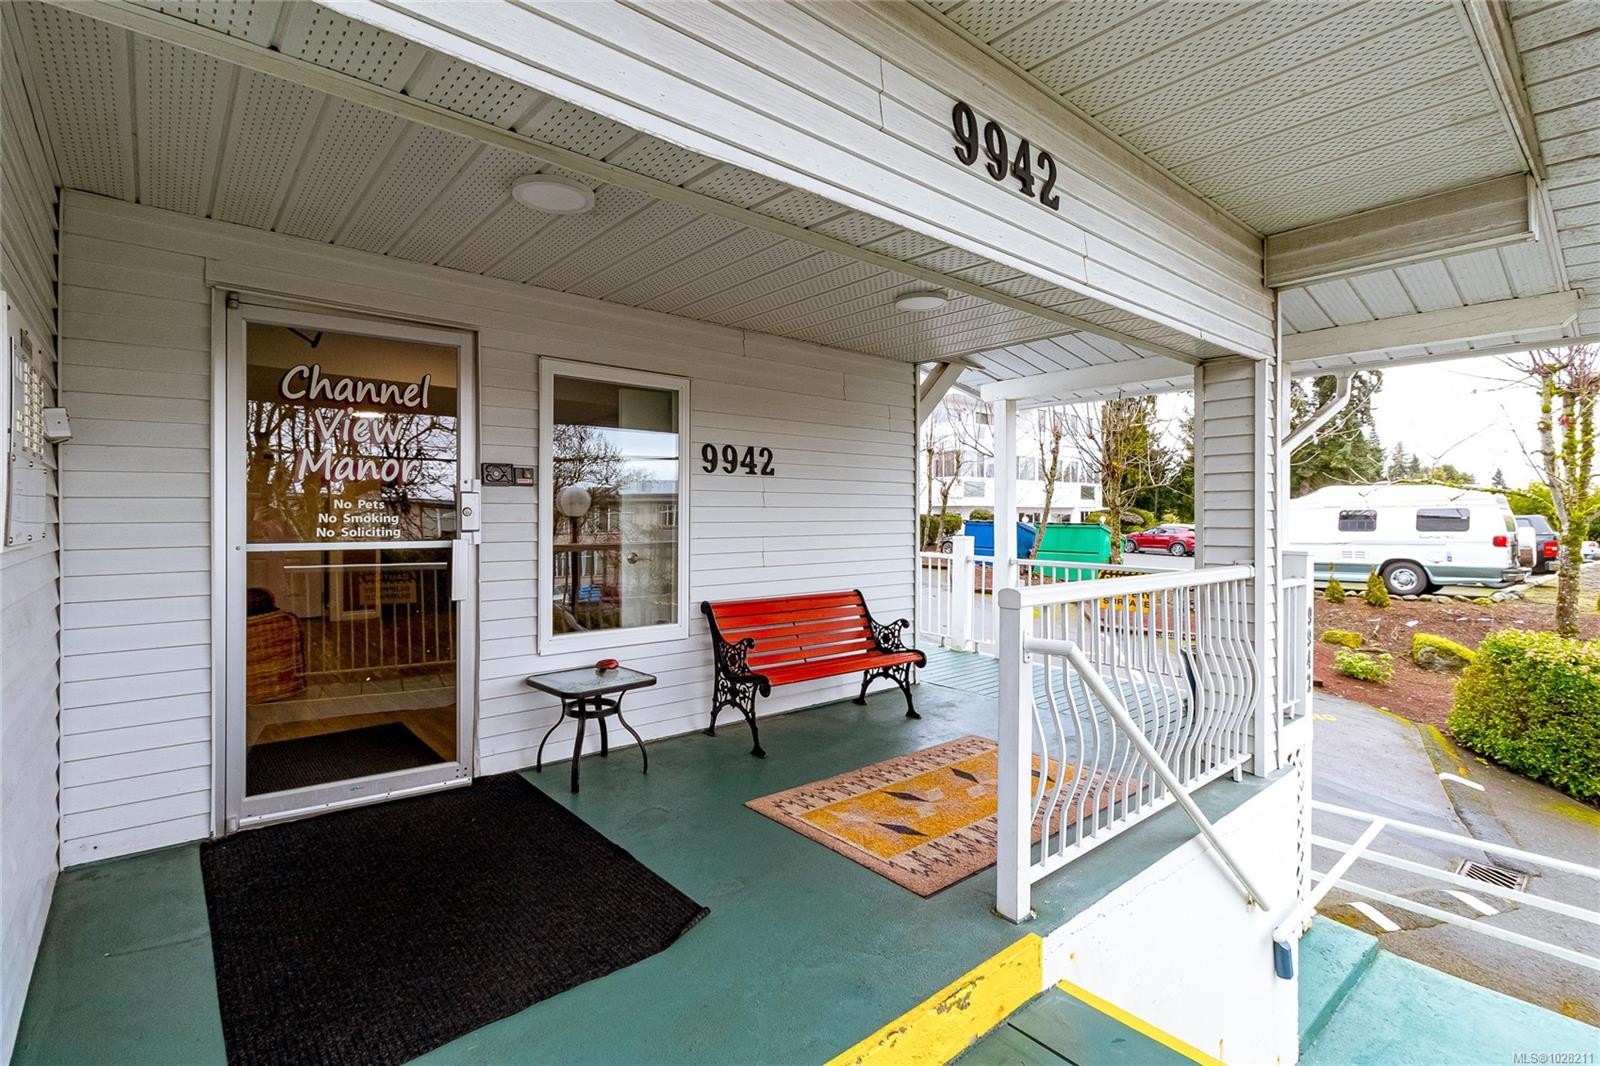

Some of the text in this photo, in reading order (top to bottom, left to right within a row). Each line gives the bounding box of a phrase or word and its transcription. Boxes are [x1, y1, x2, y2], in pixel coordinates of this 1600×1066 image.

[952, 101, 1060, 211] 9942
[281, 364, 432, 409] Channel
[315, 407, 403, 443] View
[298, 448, 420, 482] Manor
[701, 443, 775, 476] 9942
[318, 513, 399, 525] No Smoking
[333, 499, 385, 510] No Pets
[316, 527, 401, 539] No Soliciting
